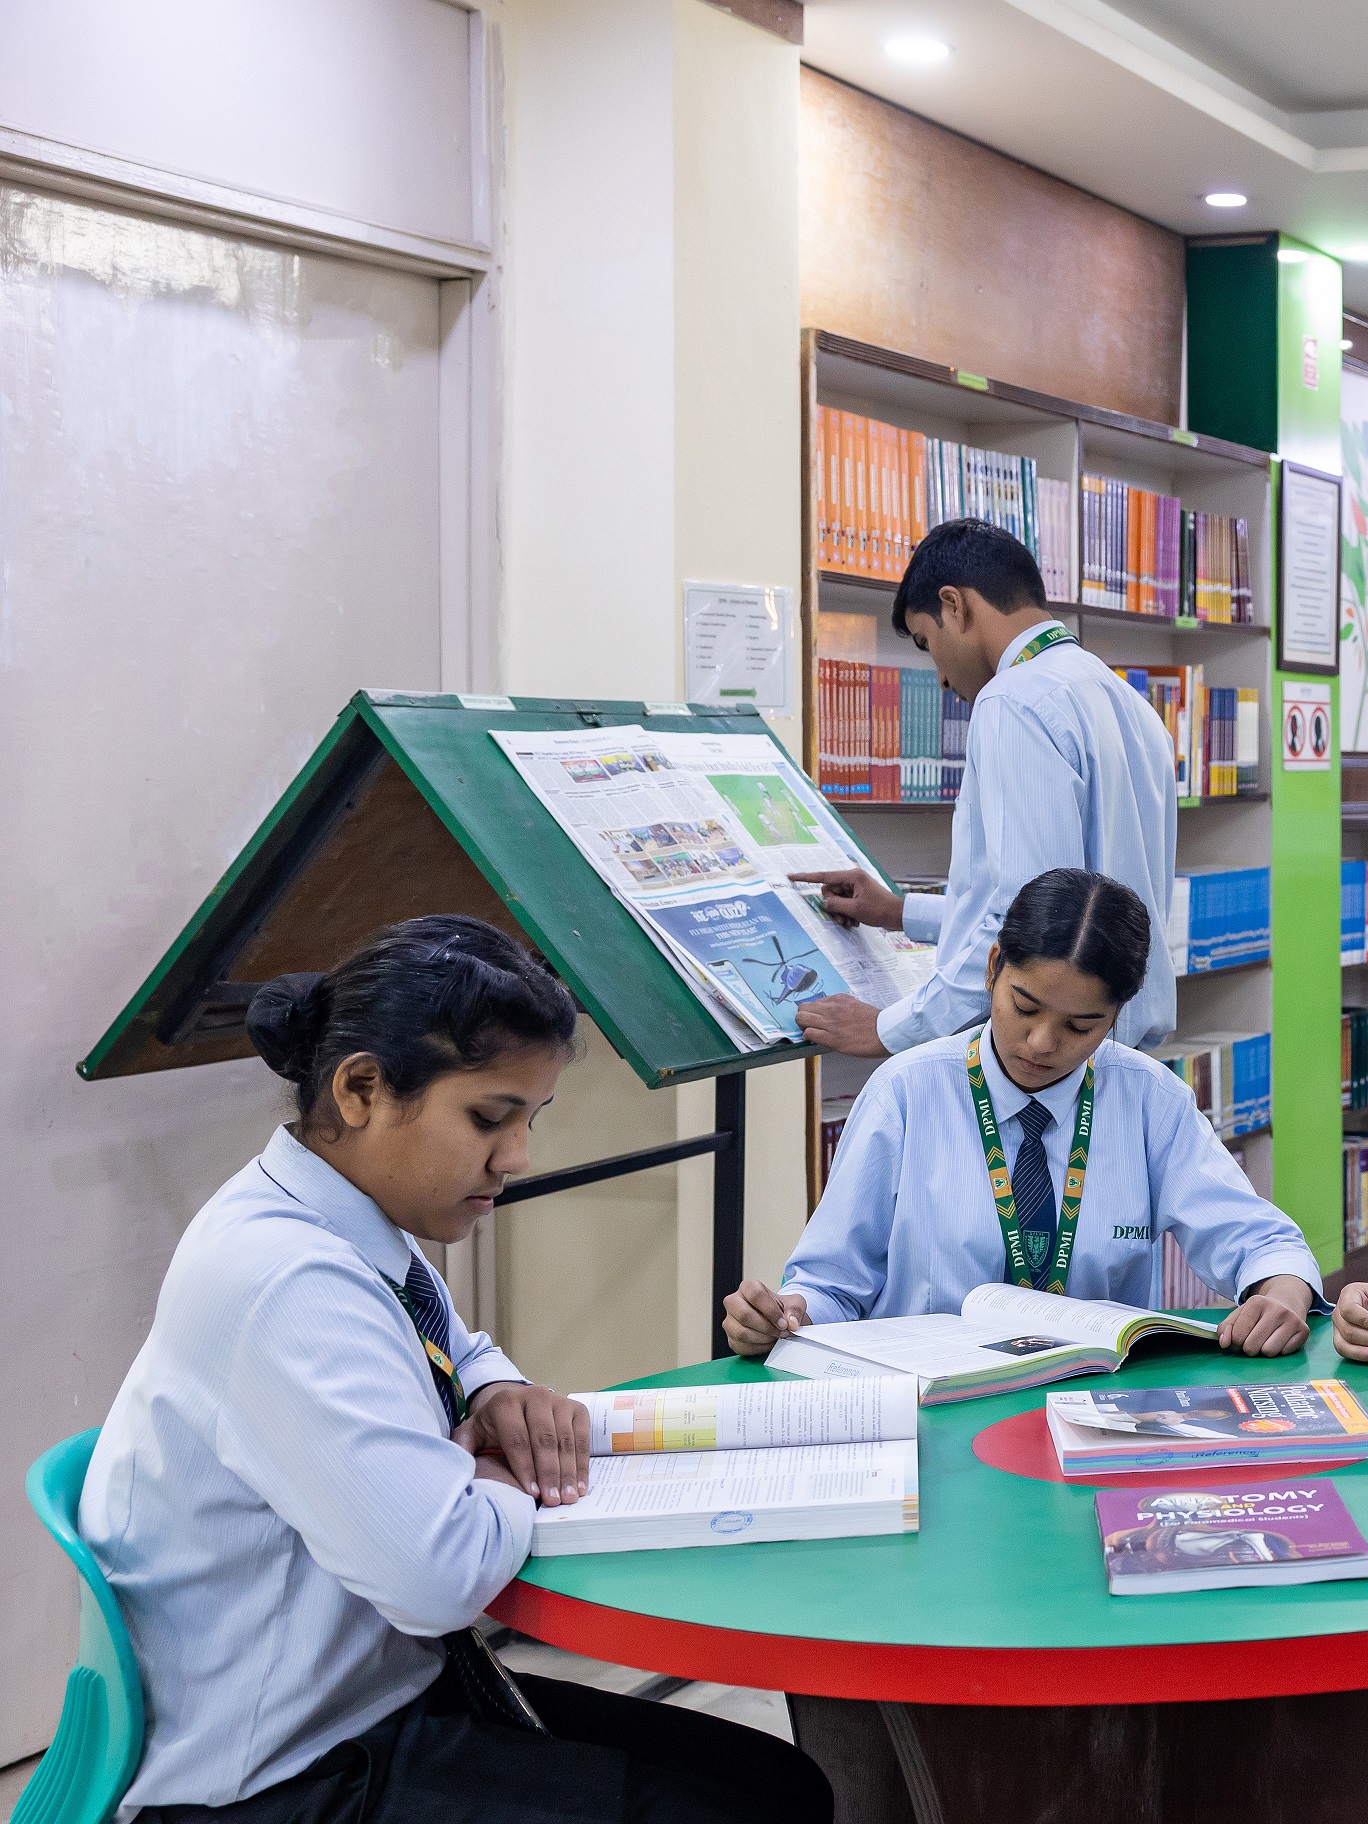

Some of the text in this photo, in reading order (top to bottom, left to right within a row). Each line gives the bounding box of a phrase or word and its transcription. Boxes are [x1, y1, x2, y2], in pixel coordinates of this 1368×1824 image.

[978, 1098, 996, 1136] DPMI
[1079, 1100, 1092, 1137] DPMI
[1007, 1229, 1026, 1268] DPMI
[1112, 1225, 1150, 1240] DPMI
[1055, 1230, 1074, 1269] DPMI
[826, 1362, 860, 1377] Reference
[1244, 1387, 1287, 1419] Nursing
[1278, 1385, 1320, 1419] Pediatric
[1195, 1449, 1258, 1459] Reference
[1137, 1503, 1324, 1521] PHYSIOLOGY
[1150, 1489, 1318, 1507] ANATOMY
